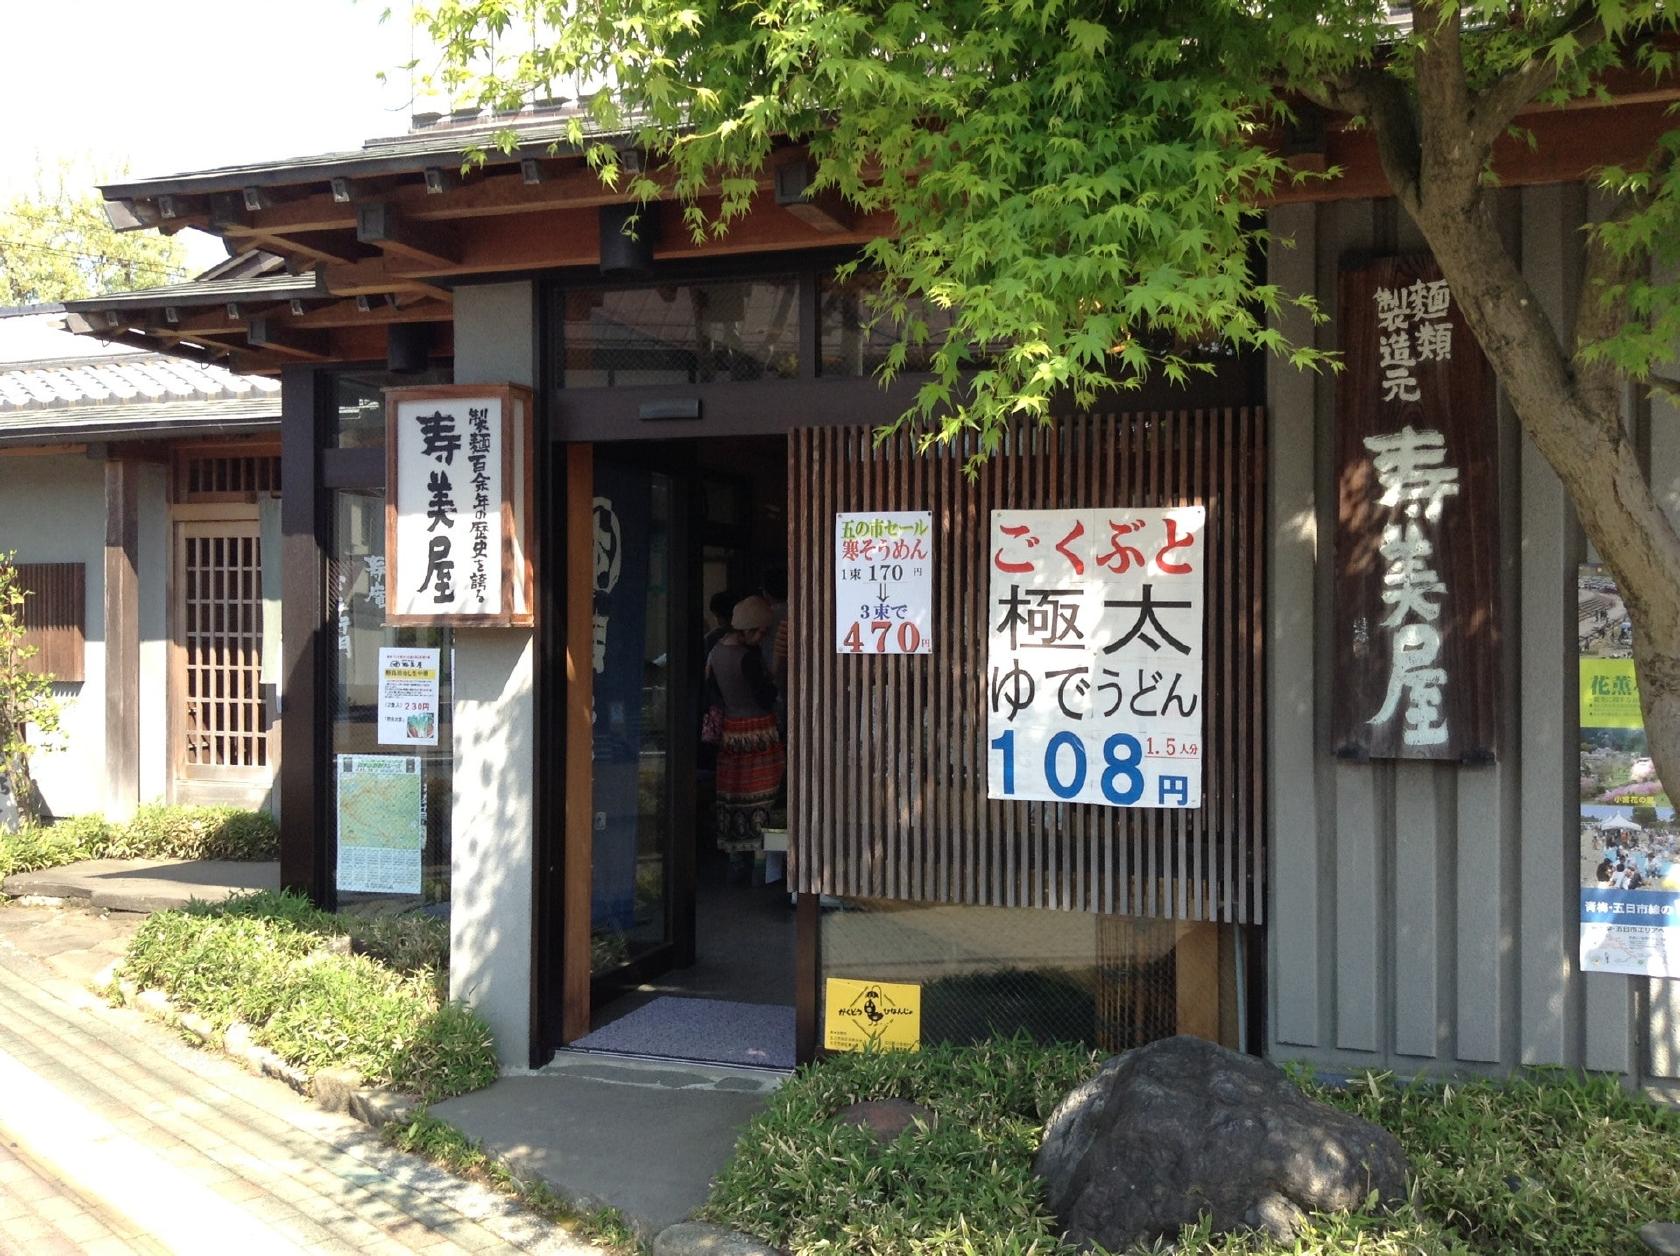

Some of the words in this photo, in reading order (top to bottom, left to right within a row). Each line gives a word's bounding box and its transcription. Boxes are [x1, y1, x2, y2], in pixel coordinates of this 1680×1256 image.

[1373, 286, 1421, 401] 製造元
[416, 411, 461, 603] 寿美屋
[842, 519, 928, 538] 五の市セール
[842, 539, 928, 561] 寒そうめん
[994, 518, 1195, 575] ごくぶと
[1363, 425, 1460, 746] 寿美屋
[843, 621, 930, 652] 470円
[996, 584, 1192, 655] 極太
[992, 658, 1198, 721] ゆでうどん
[1591, 675, 1637, 695] 花薫
[991, 729, 1189, 805] 108円
